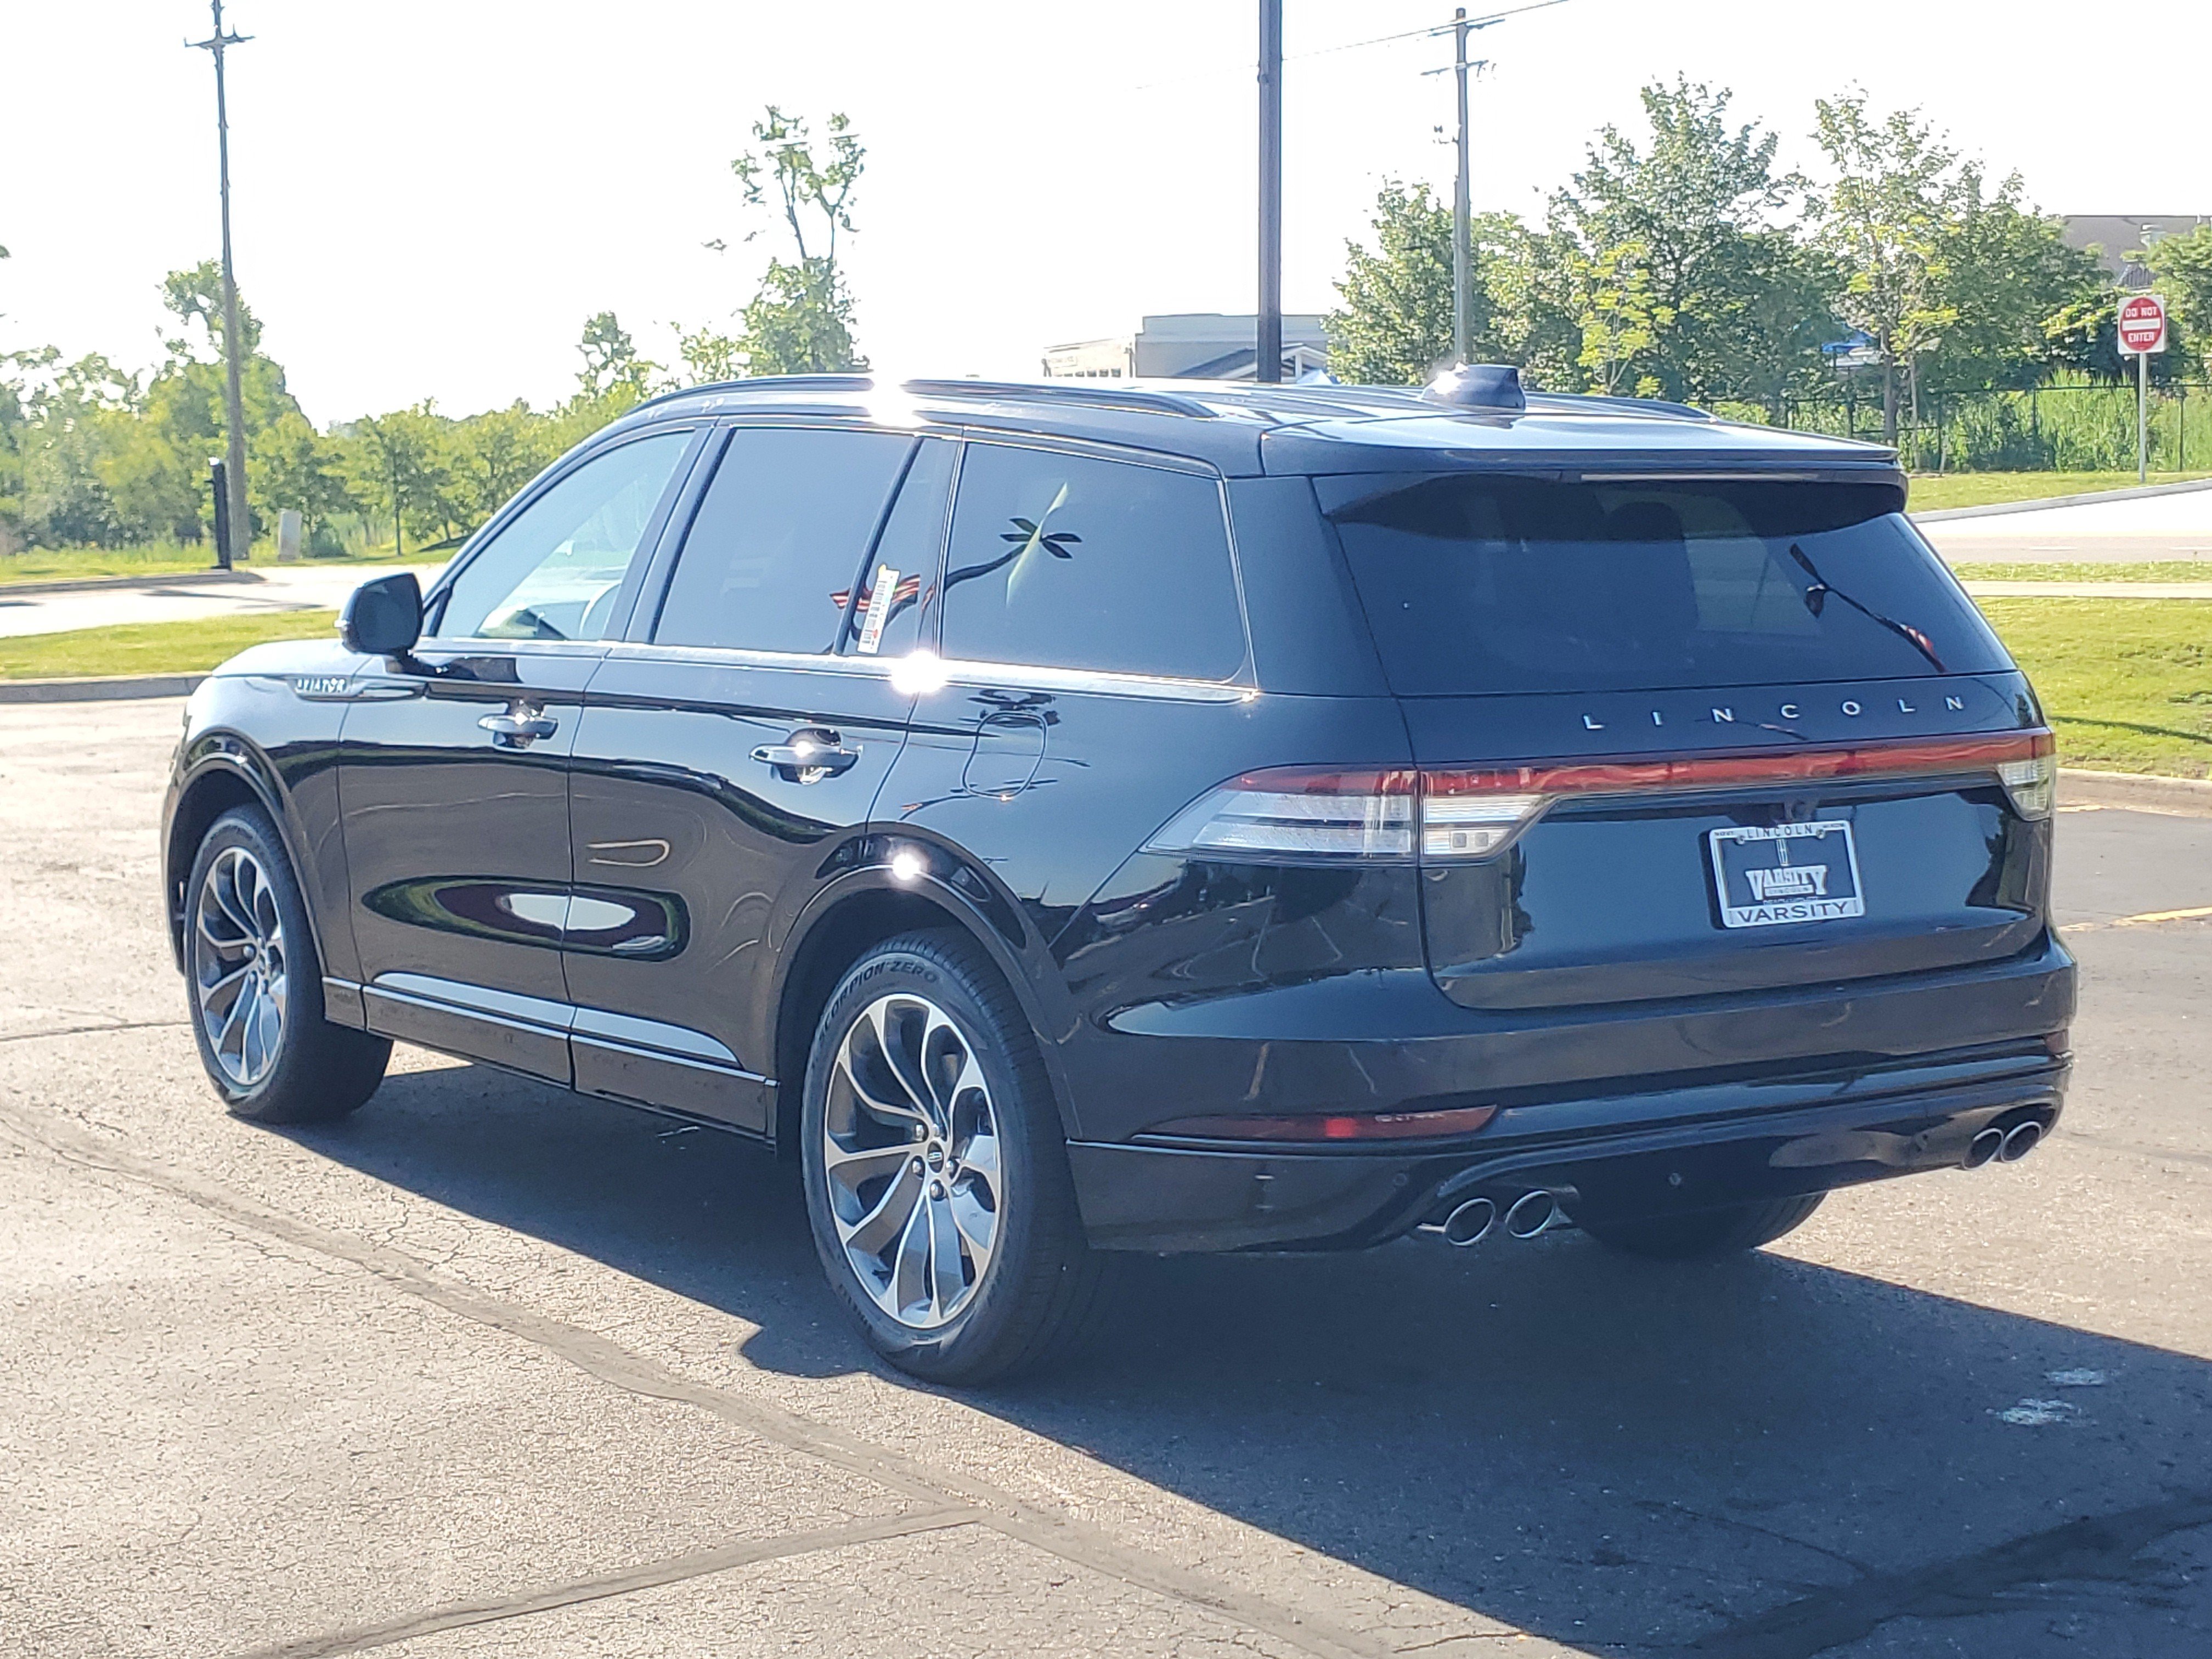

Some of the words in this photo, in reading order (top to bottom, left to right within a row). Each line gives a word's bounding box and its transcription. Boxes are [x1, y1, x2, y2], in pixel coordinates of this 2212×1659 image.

[2125, 308, 2138, 318] DO
[2141, 307, 2158, 316] NOT
[2128, 331, 2154, 343] ENTER
[1583, 696, 1964, 730] LINCOLN
[1747, 824, 1813, 839] LINCOLN
[1745, 864, 1828, 901] VARSITY
[1737, 901, 1848, 923] VARSITY
[889, 961, 938, 984] ZERO
